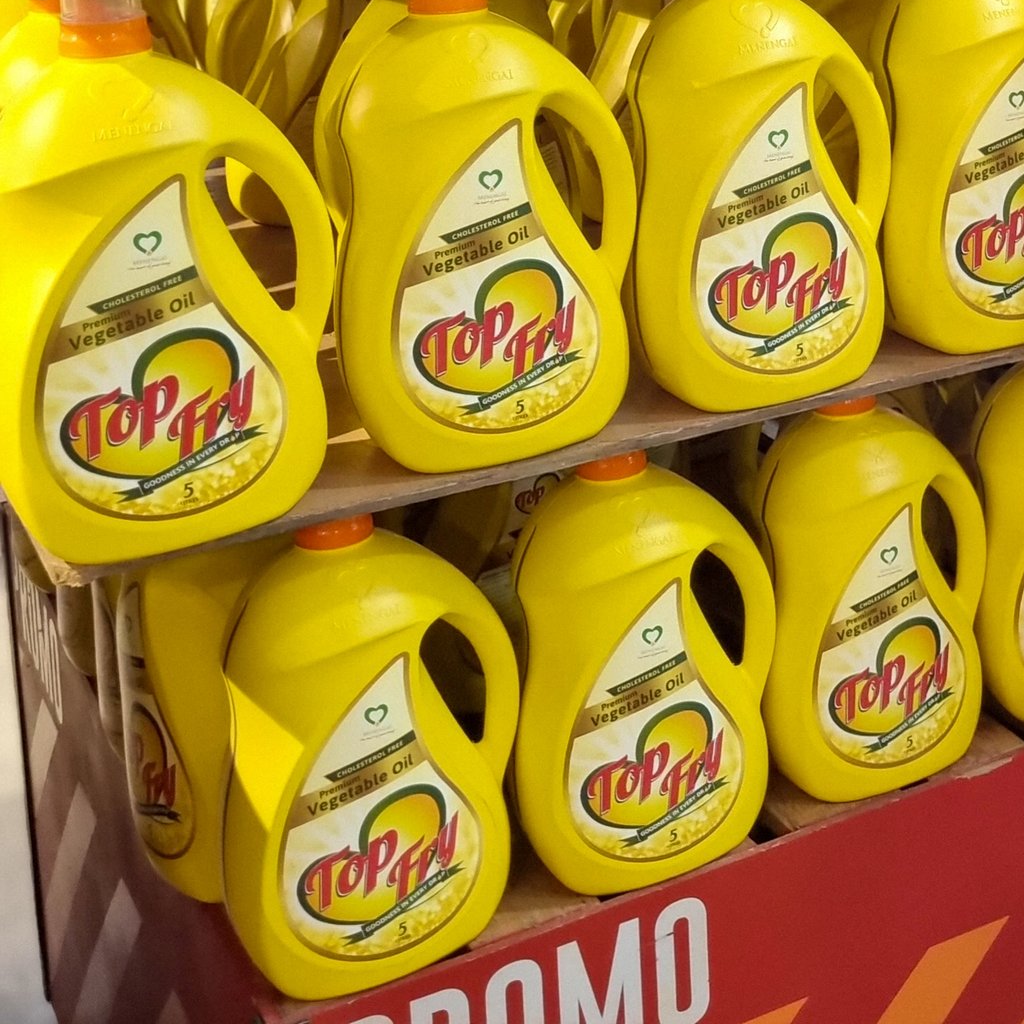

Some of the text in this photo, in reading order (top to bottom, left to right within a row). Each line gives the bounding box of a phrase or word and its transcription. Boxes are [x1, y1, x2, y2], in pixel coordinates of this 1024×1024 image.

[744, 167, 801, 194] CHOLESTEROL FREE
[966, 152, 1023, 184] Vegetable
[718, 182, 808, 229] Vegetable Oil
[728, 194, 763, 212] Premium
[452, 210, 519, 239] CHOLESTEROL FREE
[423, 226, 528, 276] Vegetable Oil
[435, 240, 474, 259] Premium
[103, 275, 182, 309] CHOLESTEROL FREE
[69, 291, 194, 350] Vegetable Oil
[83, 309, 130, 331] Premium
[796, 342, 803, 356] 5
[515, 400, 524, 414] 5
[183, 482, 194, 498] 5
[838, 591, 915, 641] Vegetable Oil
[618, 669, 660, 691] CHOLESTEROL
[591, 673, 683, 726] Vegetable Oil
[602, 690, 637, 710] Premium
[906, 734, 912, 747] 5
[338, 751, 385, 777] CHOLESTEROL
[308, 754, 412, 816] Vegetable Oil
[320, 774, 360, 799] Premium
[669, 827, 677, 841] 5
[398, 920, 407, 936] 5
[349, 897, 710, 1024] OMO
